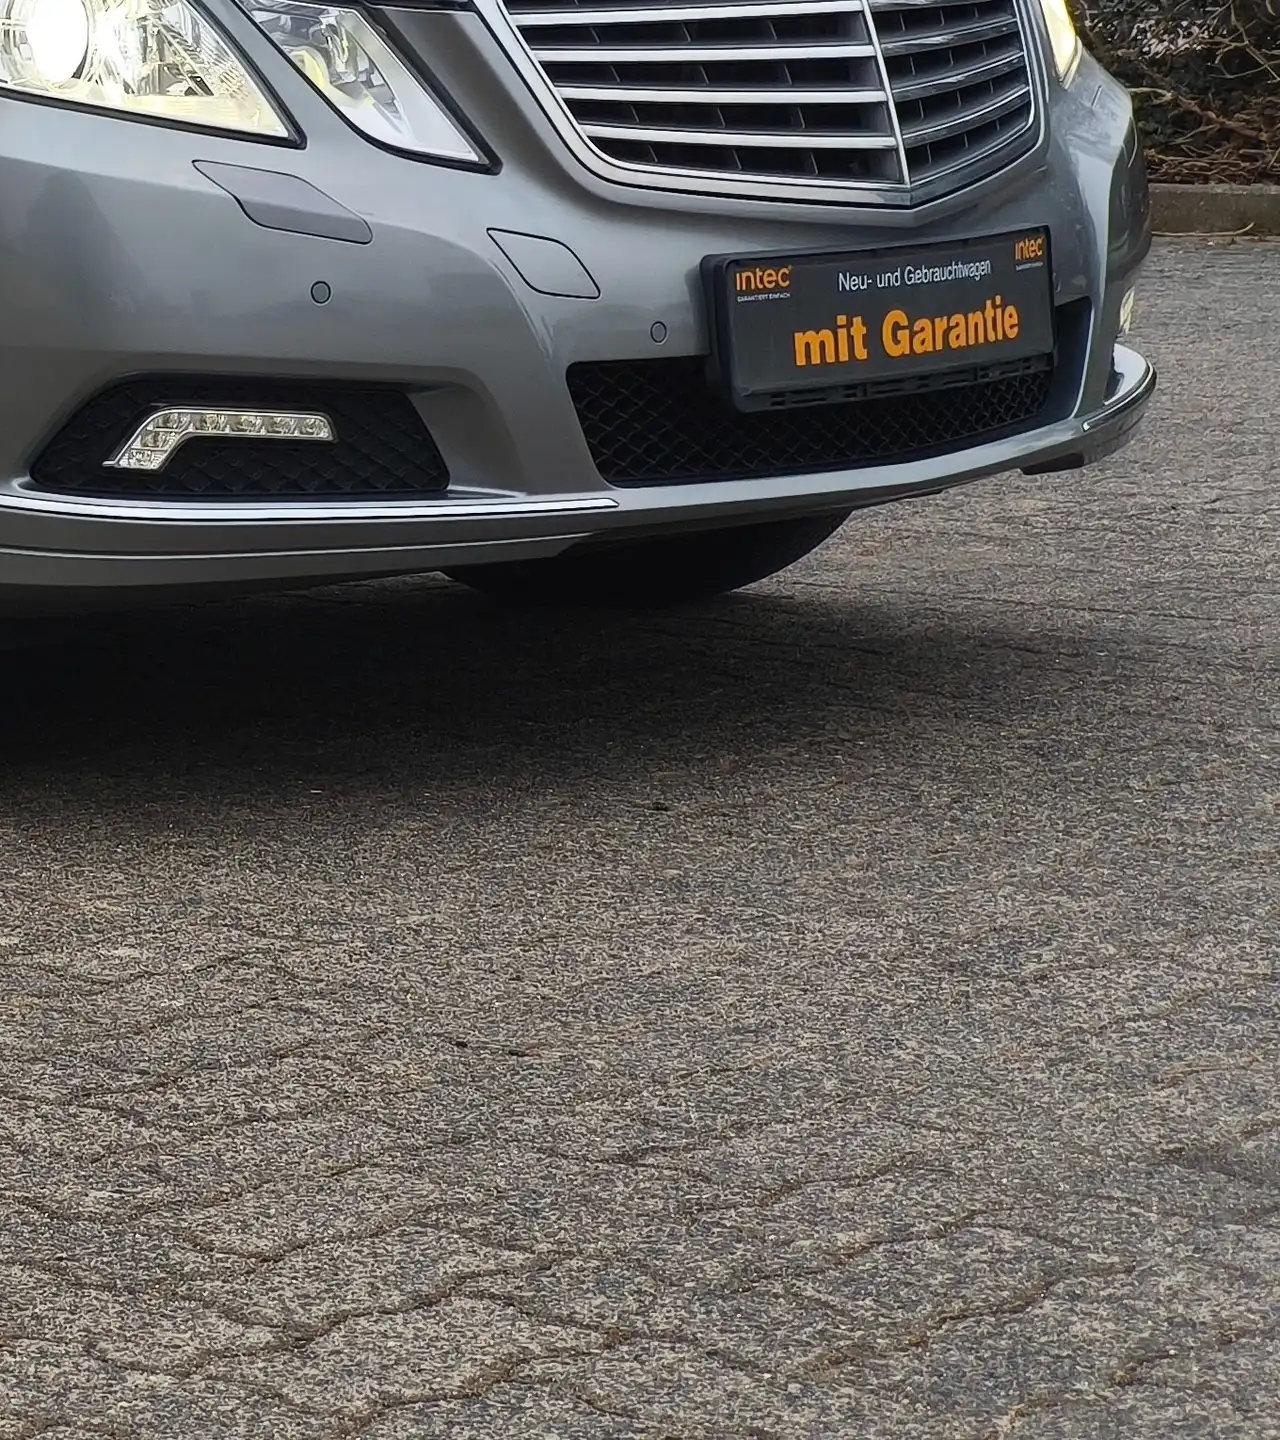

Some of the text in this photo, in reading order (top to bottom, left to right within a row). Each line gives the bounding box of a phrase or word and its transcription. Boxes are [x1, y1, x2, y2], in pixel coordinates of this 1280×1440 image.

[838, 271, 873, 292] Neu-
[876, 268, 901, 288] und
[904, 260, 992, 285] Gebrauchtwagen
[794, 295, 1019, 366] mit Garantie
